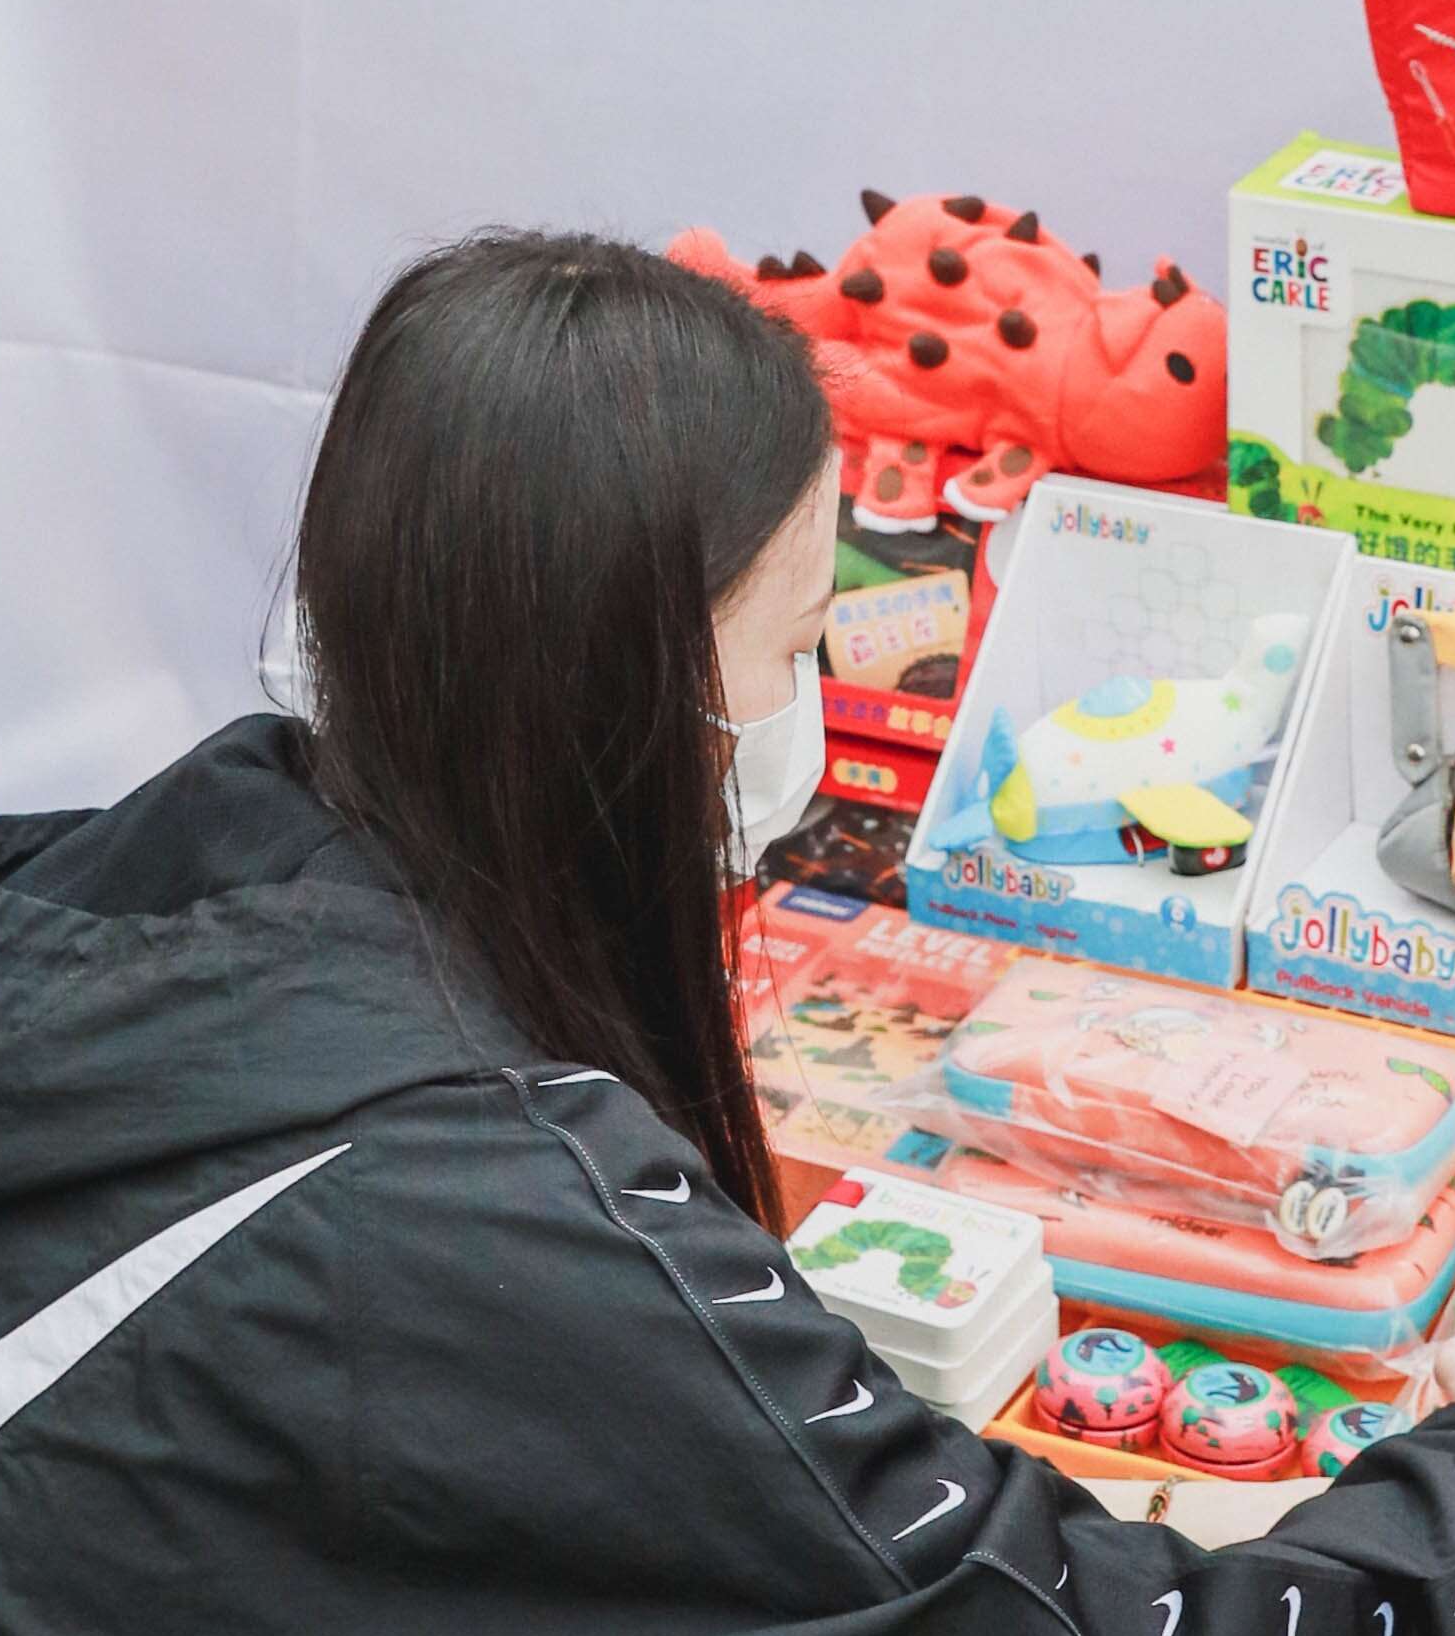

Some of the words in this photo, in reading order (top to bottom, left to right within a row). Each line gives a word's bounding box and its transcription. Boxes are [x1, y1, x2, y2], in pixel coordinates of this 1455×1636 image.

[1252, 277, 1330, 312] CARLE
[1049, 504, 1150, 546] jollybaby
[1355, 504, 1390, 523] The
[1399, 512, 1444, 536] Very
[948, 852, 1062, 901] jollybaby
[866, 918, 993, 967] LEVEL
[1276, 968, 1355, 1003] Pullback
[1362, 987, 1431, 1020] Vehicle
